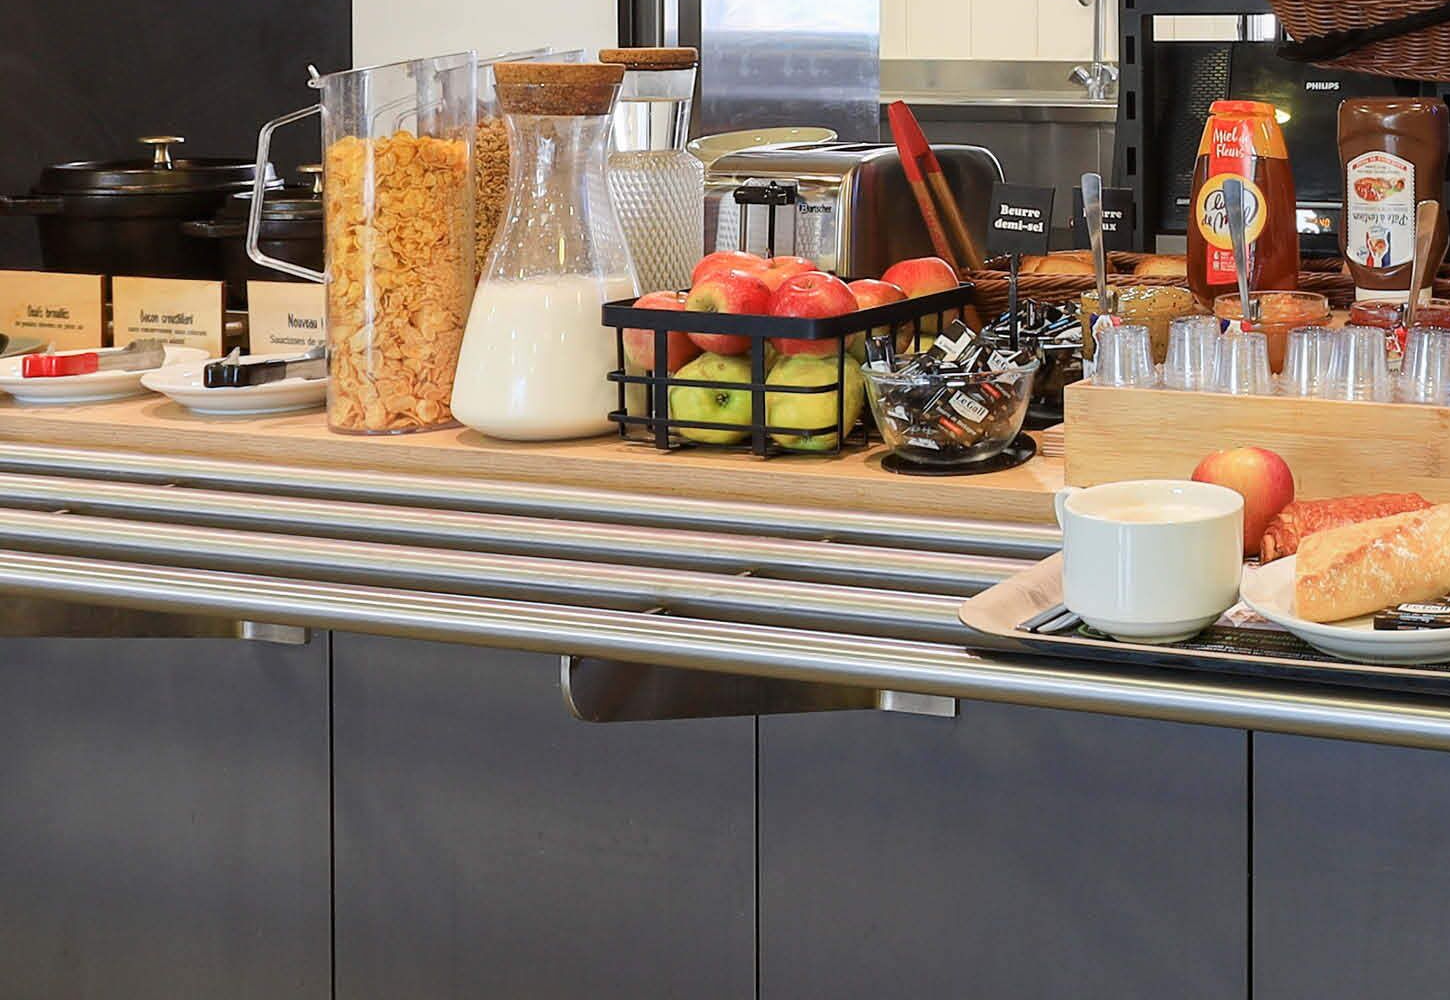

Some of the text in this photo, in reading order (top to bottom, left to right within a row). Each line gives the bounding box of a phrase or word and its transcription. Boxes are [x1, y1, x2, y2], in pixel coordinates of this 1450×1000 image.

[1306, 82, 1340, 91] PHILIPS
[1213, 128, 1239, 144] Miel
[1000, 204, 1041, 218] Beurre
[994, 218, 1043, 233] demi-sel
[288, 312, 318, 329] Nouveau
